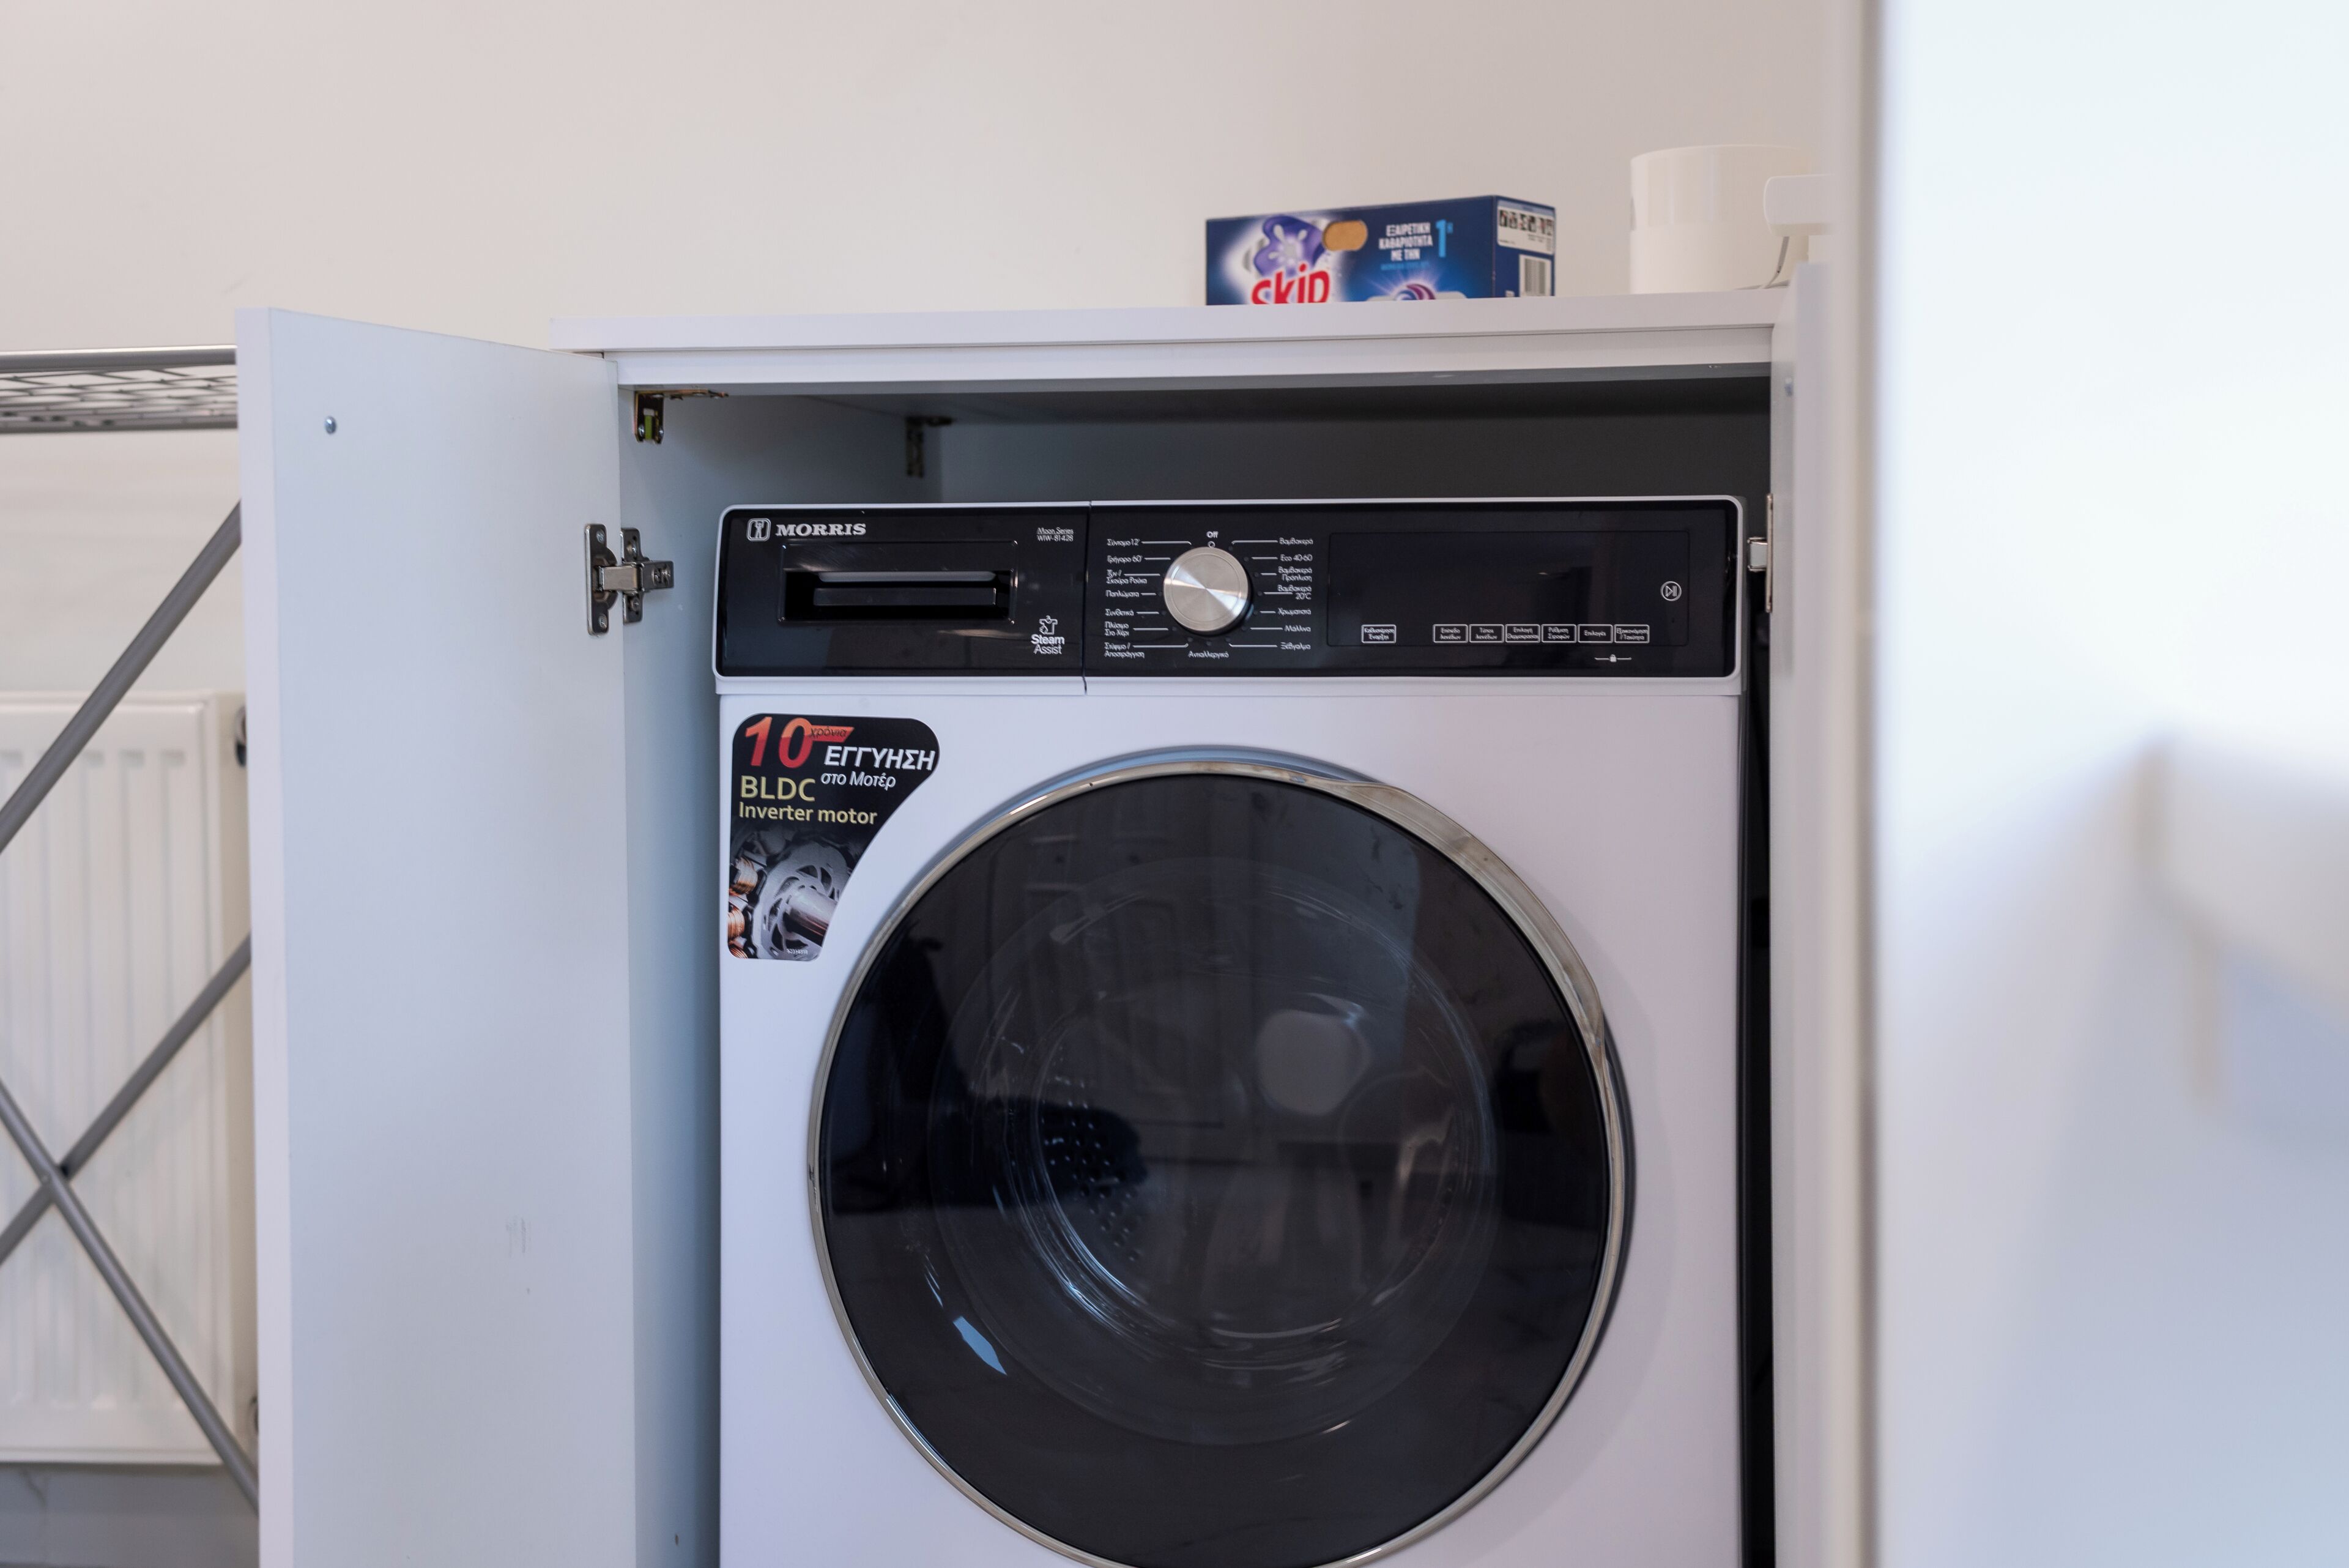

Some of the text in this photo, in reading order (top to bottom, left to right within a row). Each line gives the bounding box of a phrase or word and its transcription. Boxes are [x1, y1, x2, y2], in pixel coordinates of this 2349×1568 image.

[775, 523, 866, 537] MORRIS
[1031, 634, 1065, 645] Steam
[1033, 644, 1063, 655] Assist
[745, 716, 847, 768] 10 χρόνια
[824, 745, 936, 771] ΕΓΓΥΗΣΗ
[740, 775, 816, 801] BLDC
[820, 771, 896, 790] στο Μοτέρ
[739, 801, 878, 825] Inverter motor
